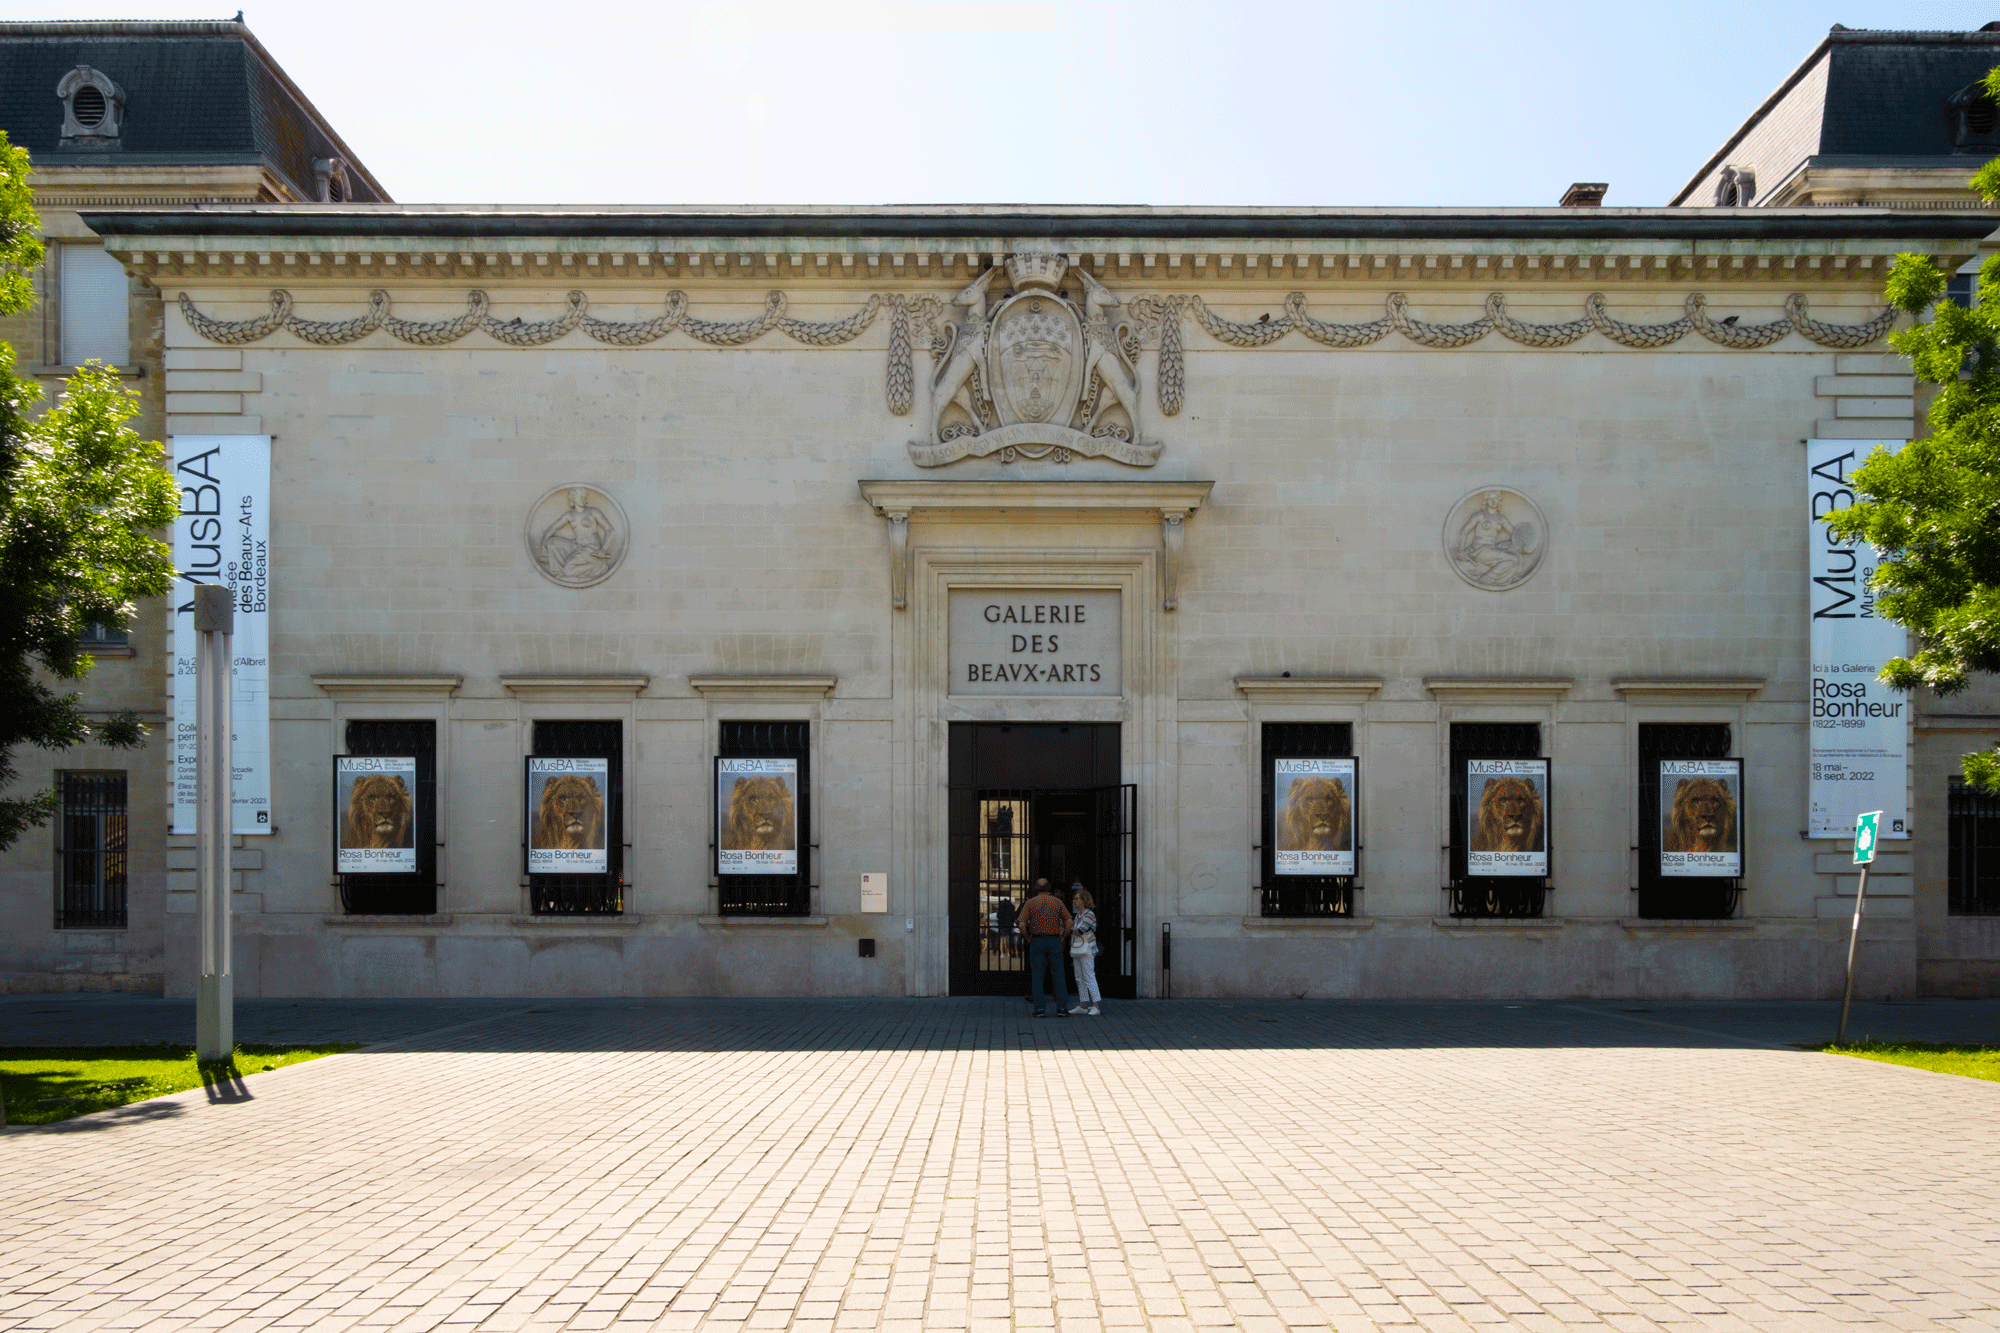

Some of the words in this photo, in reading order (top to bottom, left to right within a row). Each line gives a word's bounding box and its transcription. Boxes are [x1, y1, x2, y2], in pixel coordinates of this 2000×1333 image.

[999, 447, 1016, 462] 19
[1054, 447, 1071, 462] 38
[254, 540, 266, 612] Bordeaux
[1860, 567, 1874, 618] Musée
[239, 587, 253, 613] des
[983, 604, 1086, 624] GALERIE
[1011, 634, 1059, 653] DES
[178, 658, 190, 666] Au
[1813, 663, 1823, 673] Ici
[1823, 664, 1829, 673] à
[1831, 663, 1840, 673] la
[1842, 663, 1876, 673] Galerie
[1813, 678, 1866, 698] Rosa
[1813, 698, 1903, 718] Bonheur
[340, 759, 382, 771] MusBA
[531, 759, 574, 771] MusBA
[721, 760, 763, 771] MusBA
[1277, 760, 1320, 772] MusBA
[1470, 761, 1513, 773] MusBA
[1662, 761, 1706, 773] MusBA
[1812, 763, 1822, 771] 18
[1812, 772, 1822, 781] 18
[1824, 771, 1848, 782] sept.
[1849, 771, 1875, 781] 2022
[339, 850, 362, 859] Rosa
[364, 849, 401, 859] Bonheur
[530, 850, 553, 859] Rosa
[555, 850, 592, 859] Bonheur
[720, 851, 743, 860] Rosa
[745, 850, 783, 860] Bonheur
[1276, 852, 1299, 861] Rosa
[1301, 851, 1340, 861] Bonheur
[1469, 852, 1492, 862] Rosa
[1494, 852, 1532, 862] Bonheur
[1661, 853, 1685, 862] Rosa
[1687, 853, 1725, 862] Bonheur
